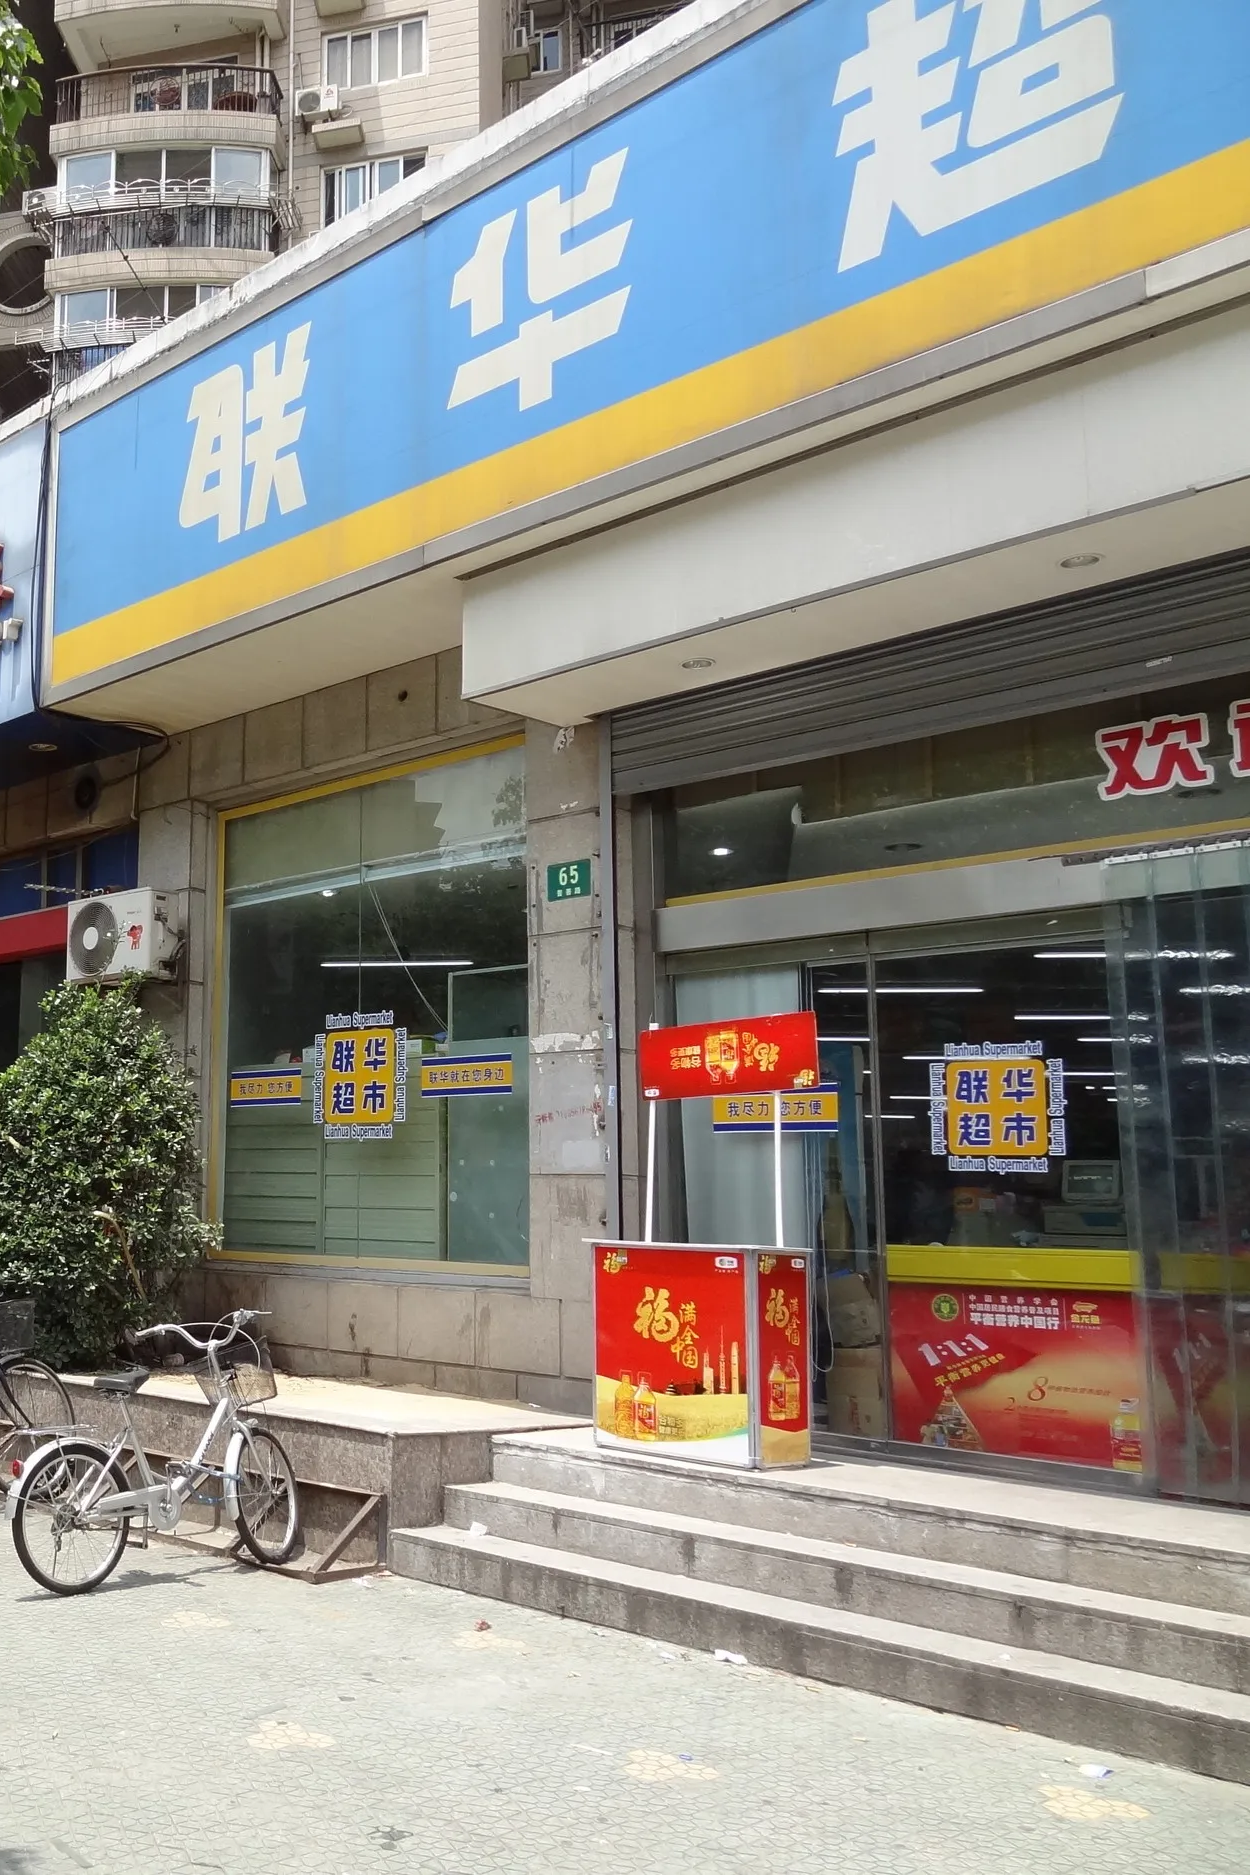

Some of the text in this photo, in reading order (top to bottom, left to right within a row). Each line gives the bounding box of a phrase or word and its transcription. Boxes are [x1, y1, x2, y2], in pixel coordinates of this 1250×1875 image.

[1095, 699, 1250, 800] 欢
[558, 865, 579, 885] 65
[326, 1010, 394, 1029] Lianhua Supermarket
[331, 1037, 387, 1073] 联华
[671, 1056, 701, 1070] 谷物多
[944, 1041, 1043, 1059] Lianhua Supermarket
[312, 1034, 326, 1123] Lianhua Supermarket
[394, 1027, 408, 1121] Lianhua Supermarket
[429, 1068, 504, 1084] 联华就在您身边
[955, 1068, 1035, 1104] 联华
[239, 1081, 293, 1095] 我尽力 您方便
[331, 1080, 387, 1115] 超市
[727, 1101, 769, 1118] 我尽力
[928, 1063, 947, 1155] Lianhua Supermarket
[1047, 1058, 1067, 1155] Lianhua Supermarket
[324, 1124, 393, 1141] Lianhua Supermarket
[957, 1112, 1036, 1147] 超市
[949, 1156, 1048, 1174] Lianhua Supermarket
[970, 1312, 1059, 1330] 平衡营养中国行
[918, 1333, 989, 1366] 1:1:1
